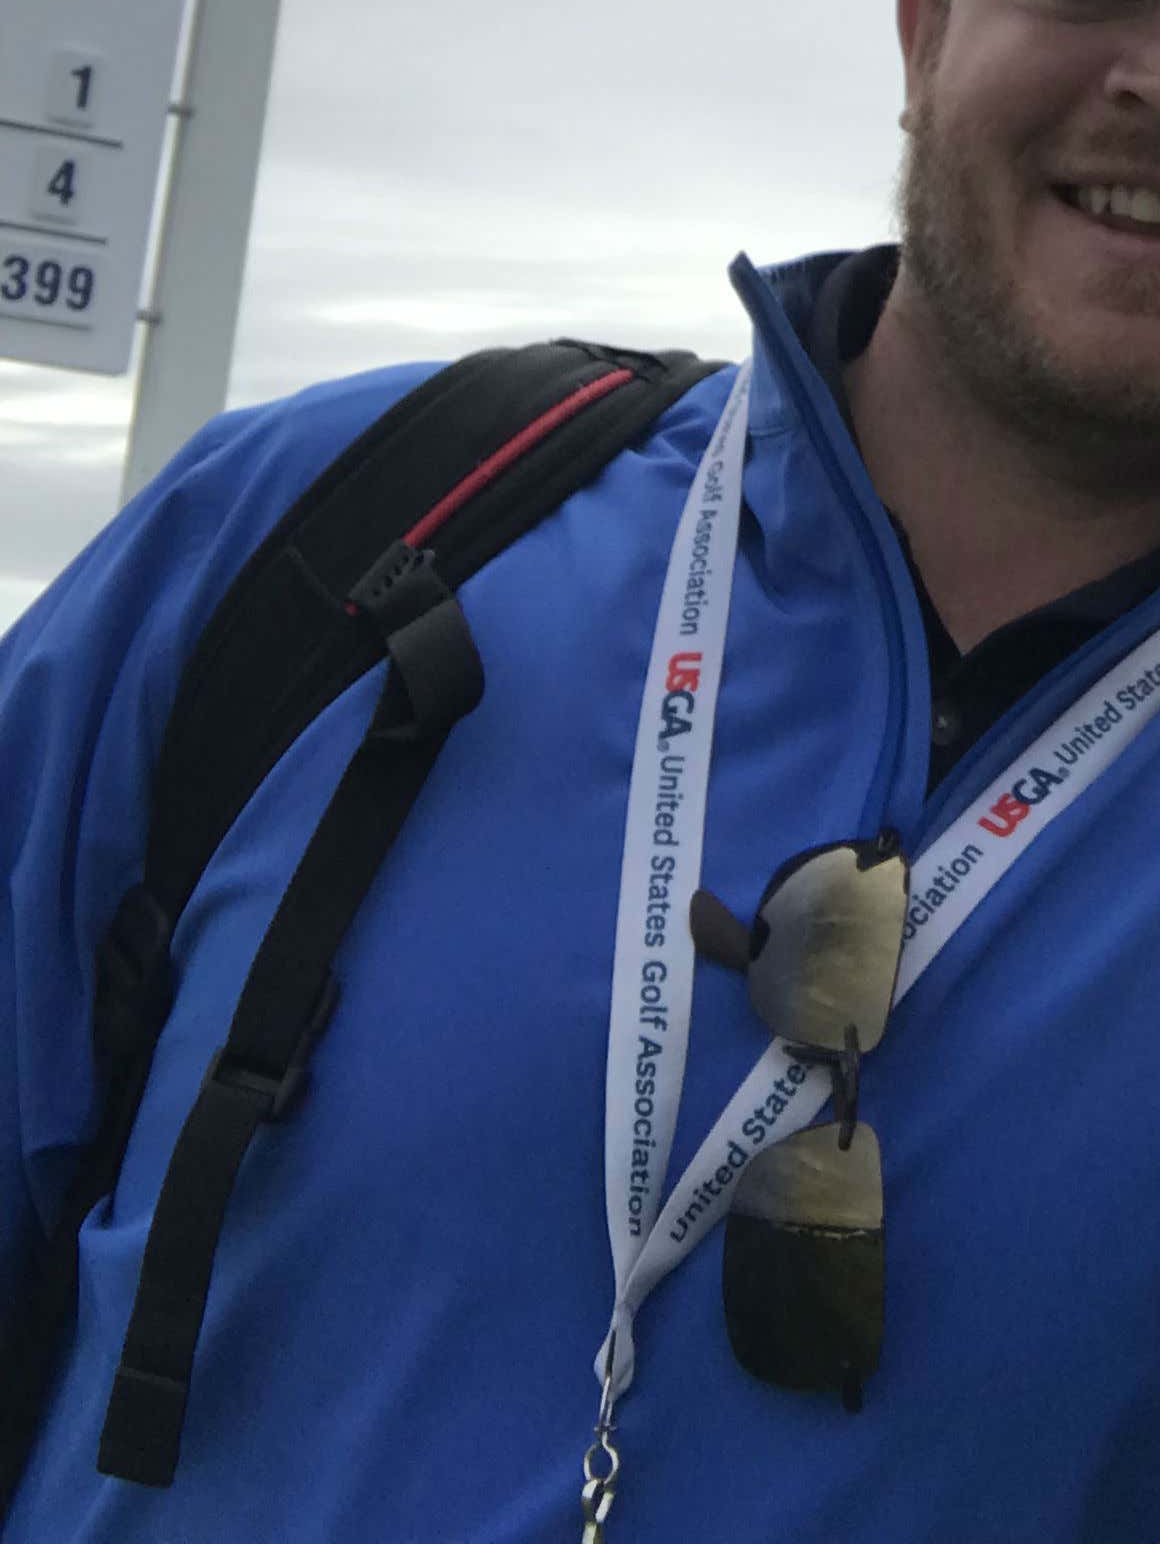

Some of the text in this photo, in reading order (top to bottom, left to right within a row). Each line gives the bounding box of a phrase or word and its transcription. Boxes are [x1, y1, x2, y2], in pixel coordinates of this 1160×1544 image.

[70, 63, 93, 110] 1
[47, 159, 76, 207] 4
[0, 255, 94, 312] 399
[679, 507, 717, 636] Association
[654, 755, 684, 846] United
[903, 844, 984, 940] ociation
[1055, 700, 1123, 766] United
[644, 857, 675, 948] States
[639, 960, 667, 1032] Golf
[628, 1036, 662, 1237] Association
[670, 1141, 746, 1244] United
